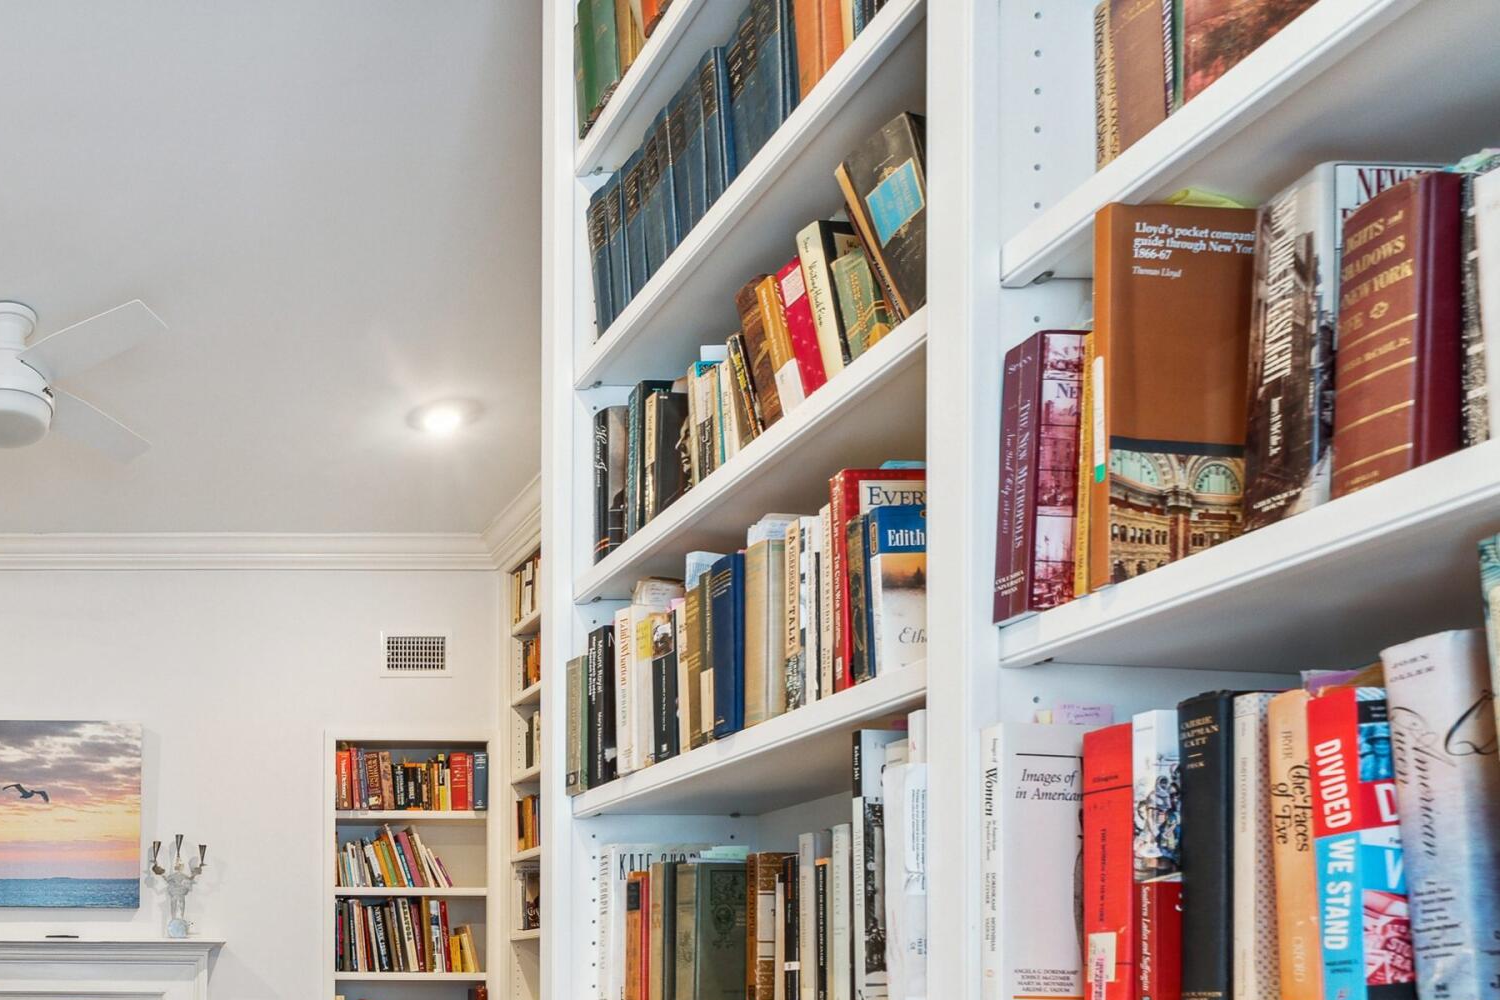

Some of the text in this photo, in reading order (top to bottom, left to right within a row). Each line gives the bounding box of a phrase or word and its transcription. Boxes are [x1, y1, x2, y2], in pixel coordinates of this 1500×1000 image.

[1133, 236, 1165, 250] guide
[1167, 237, 1206, 254] through
[1208, 241, 1232, 253] New
[1135, 223, 1173, 238] Lloyd's
[1175, 227, 1209, 240] pocket
[1133, 248, 1172, 260] 1866-67
[1161, 267, 1182, 279] Lloyd
[1373, 258, 1413, 293] YORK
[595, 425, 607, 458] Henry
[1014, 400, 1031, 549] THE NEW METROPOLIS
[867, 486, 925, 506] EVER
[788, 535, 795, 544] A
[888, 529, 926, 547] Edith
[619, 618, 628, 688] Edith Wharton
[985, 767, 998, 816] Women
[1021, 769, 1078, 785] Images of
[1314, 738, 1352, 829] DIVIDED
[1016, 788, 1083, 801] in American
[1271, 782, 1293, 845] of Eve
[1292, 795, 1313, 852] Faces
[1324, 838, 1361, 951] WE STAND
[1140, 886, 1150, 992] Southern Ladies and Suffragists
